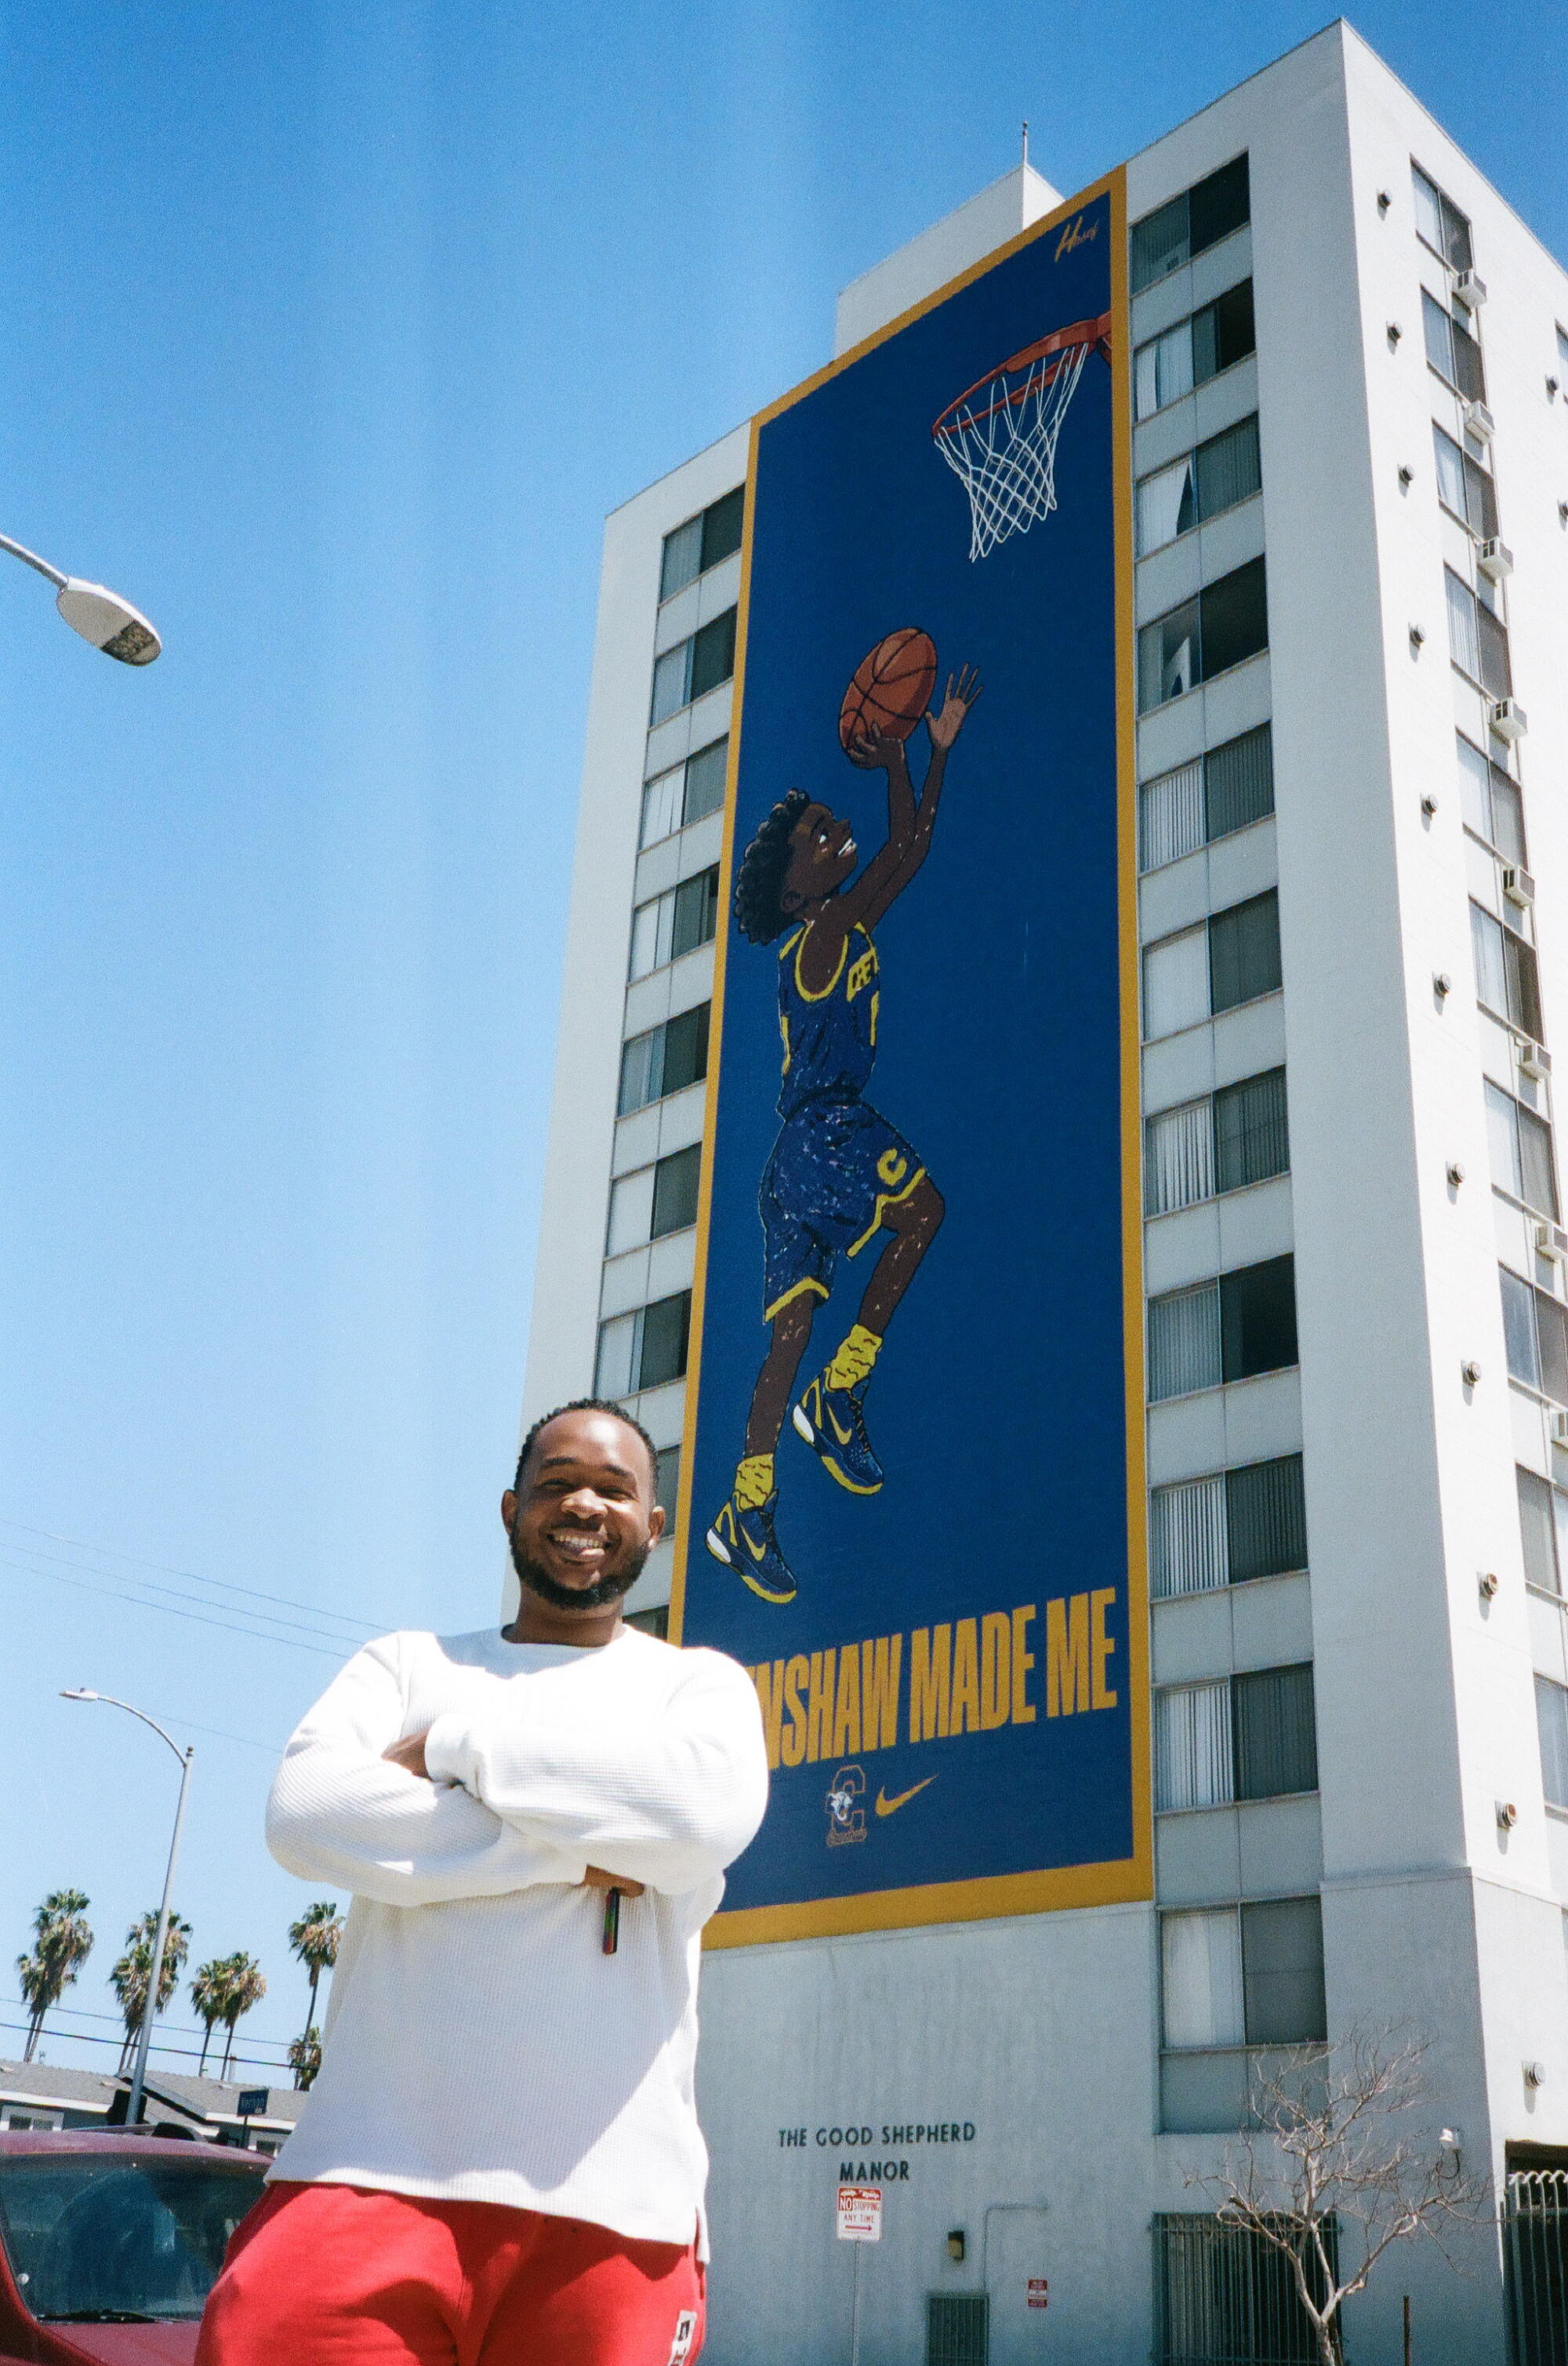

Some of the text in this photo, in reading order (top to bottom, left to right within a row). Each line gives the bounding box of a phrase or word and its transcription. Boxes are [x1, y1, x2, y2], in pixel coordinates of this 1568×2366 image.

[746, 1587, 1117, 1770] NSHAW MADE ME
[779, 2122, 975, 2147] THE GOOD SHEPHERD
[840, 2161, 909, 2182] MANOR
[840, 2197, 880, 2212] NO STOPPING
[844, 2214, 874, 2223] ANY TIME
